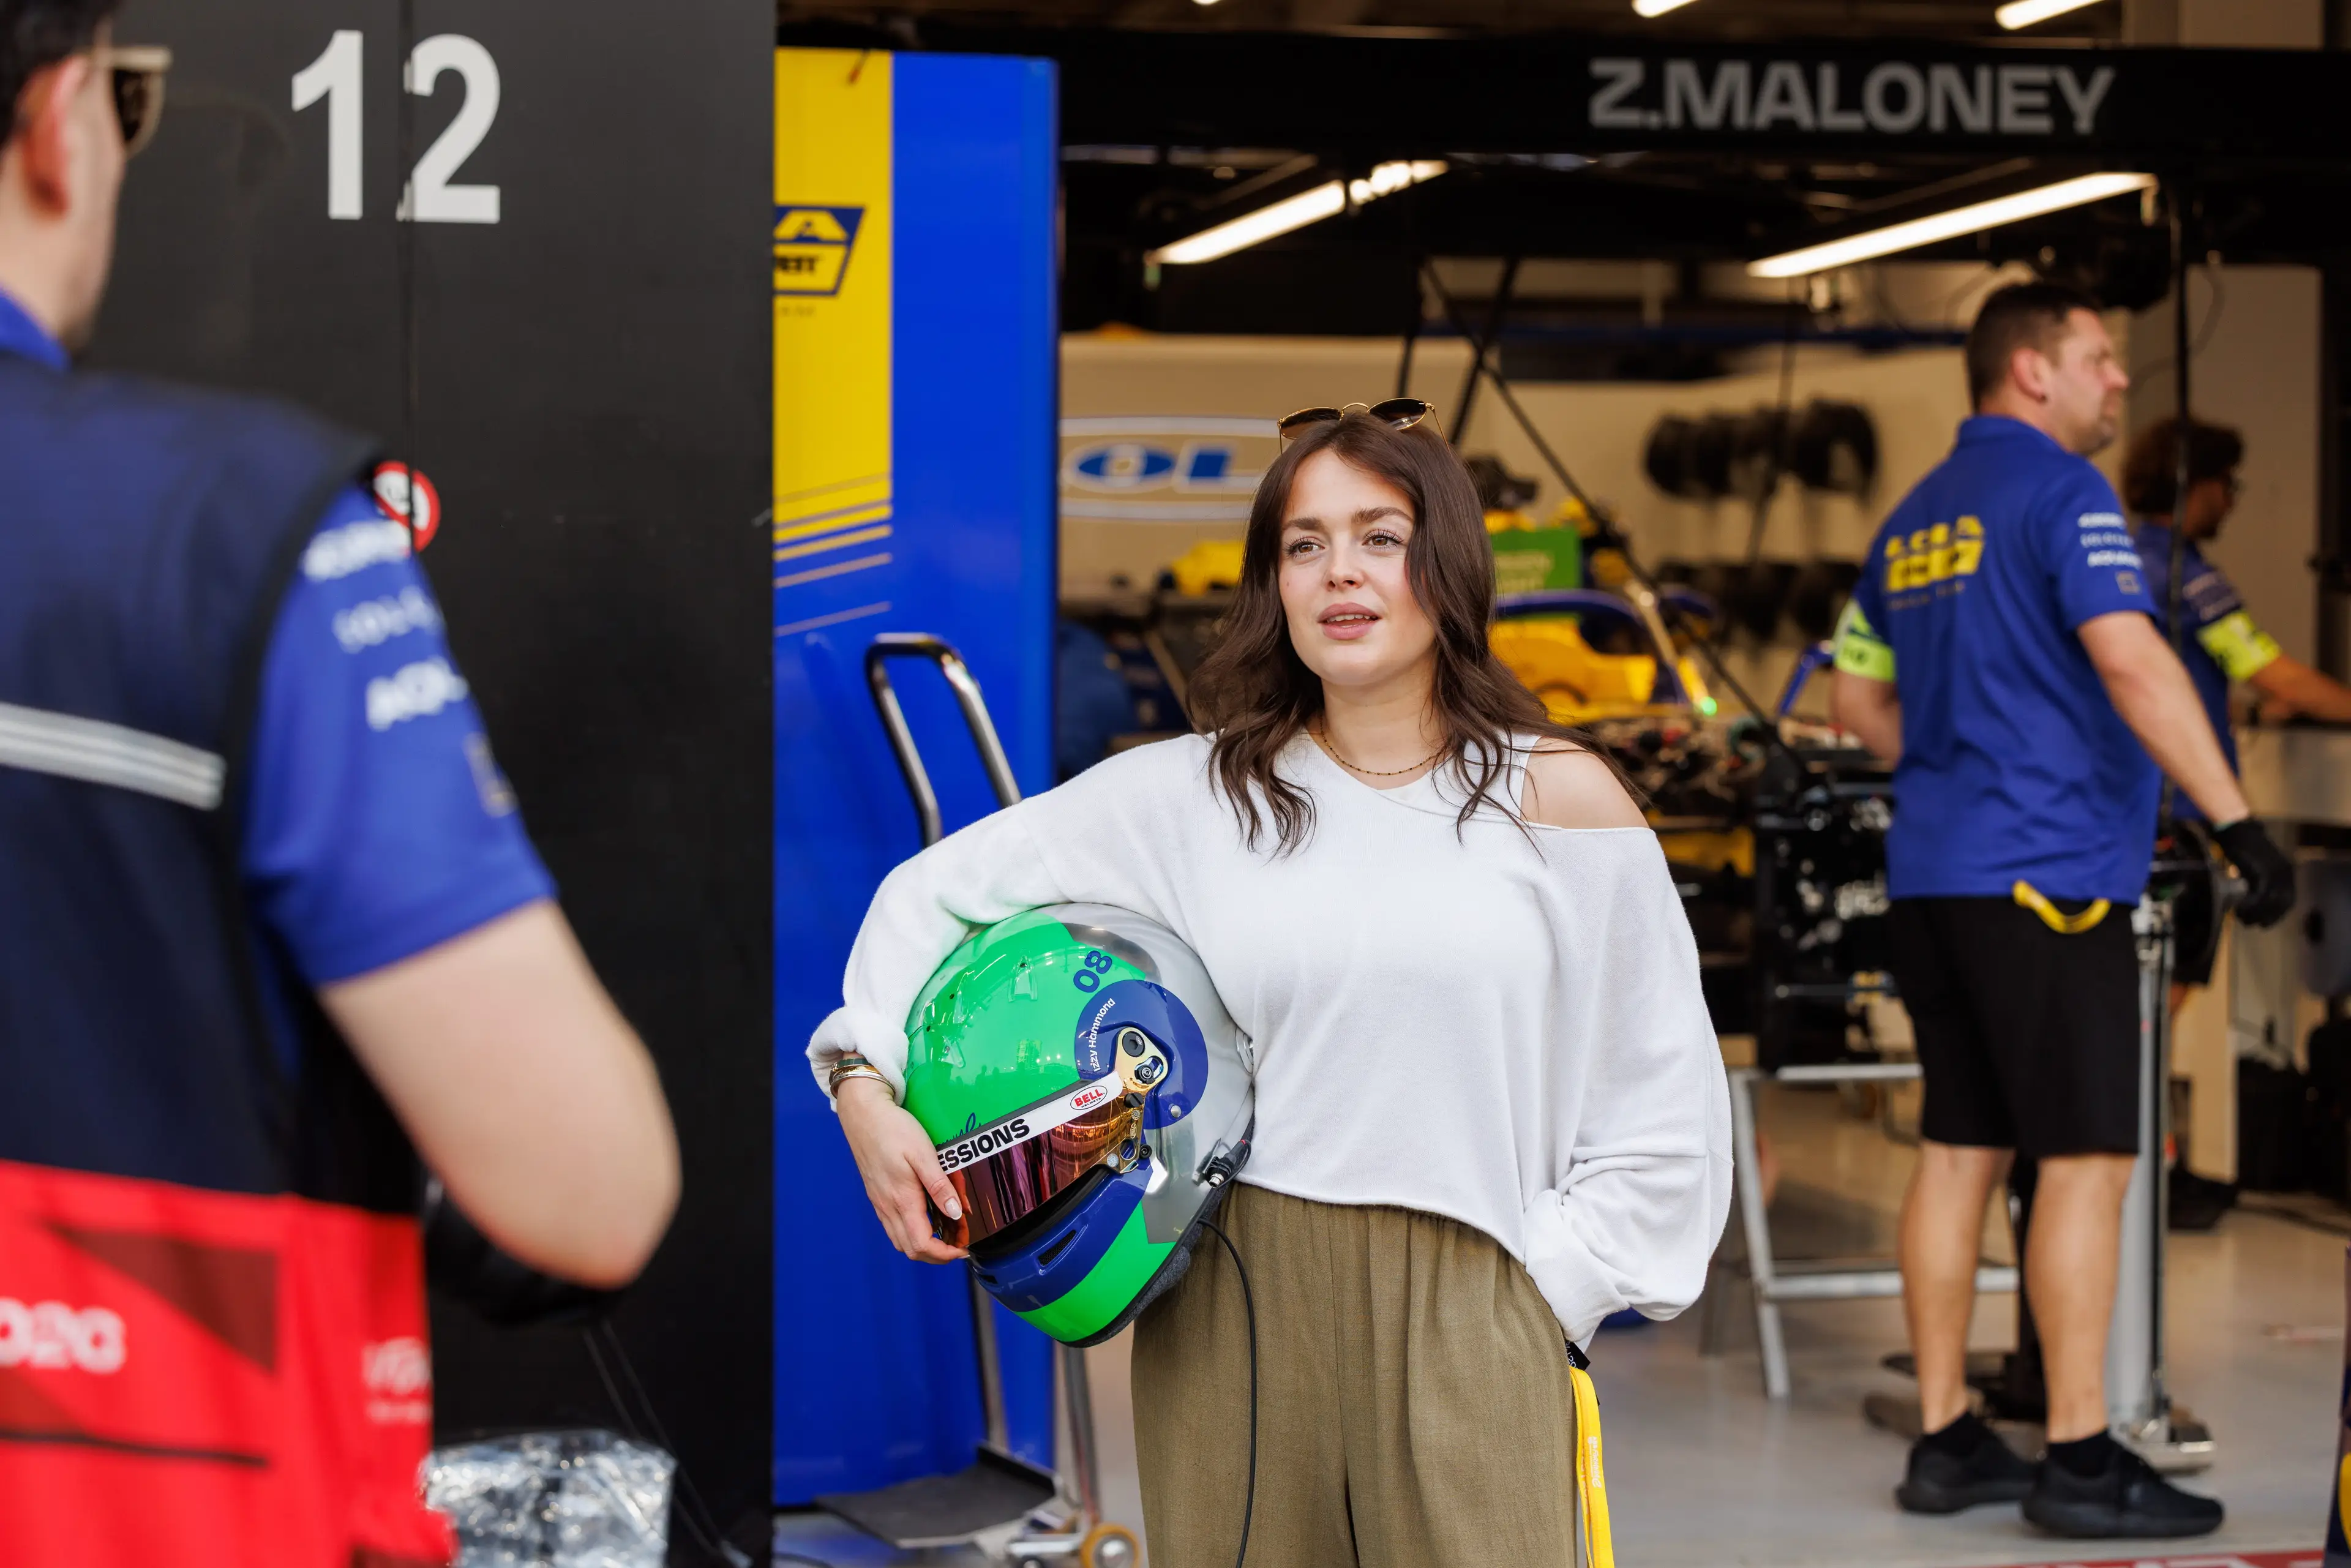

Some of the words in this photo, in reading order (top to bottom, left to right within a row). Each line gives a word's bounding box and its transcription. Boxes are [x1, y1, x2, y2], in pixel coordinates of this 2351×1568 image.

[1588, 56, 2116, 135] Z.MALONEY
[291, 29, 501, 224] 12
[1073, 950, 1112, 993] 08
[1088, 997, 1116, 1048] Hammond
[1090, 1049, 1101, 1072] Izzy
[1074, 1089, 1103, 1107] BELL
